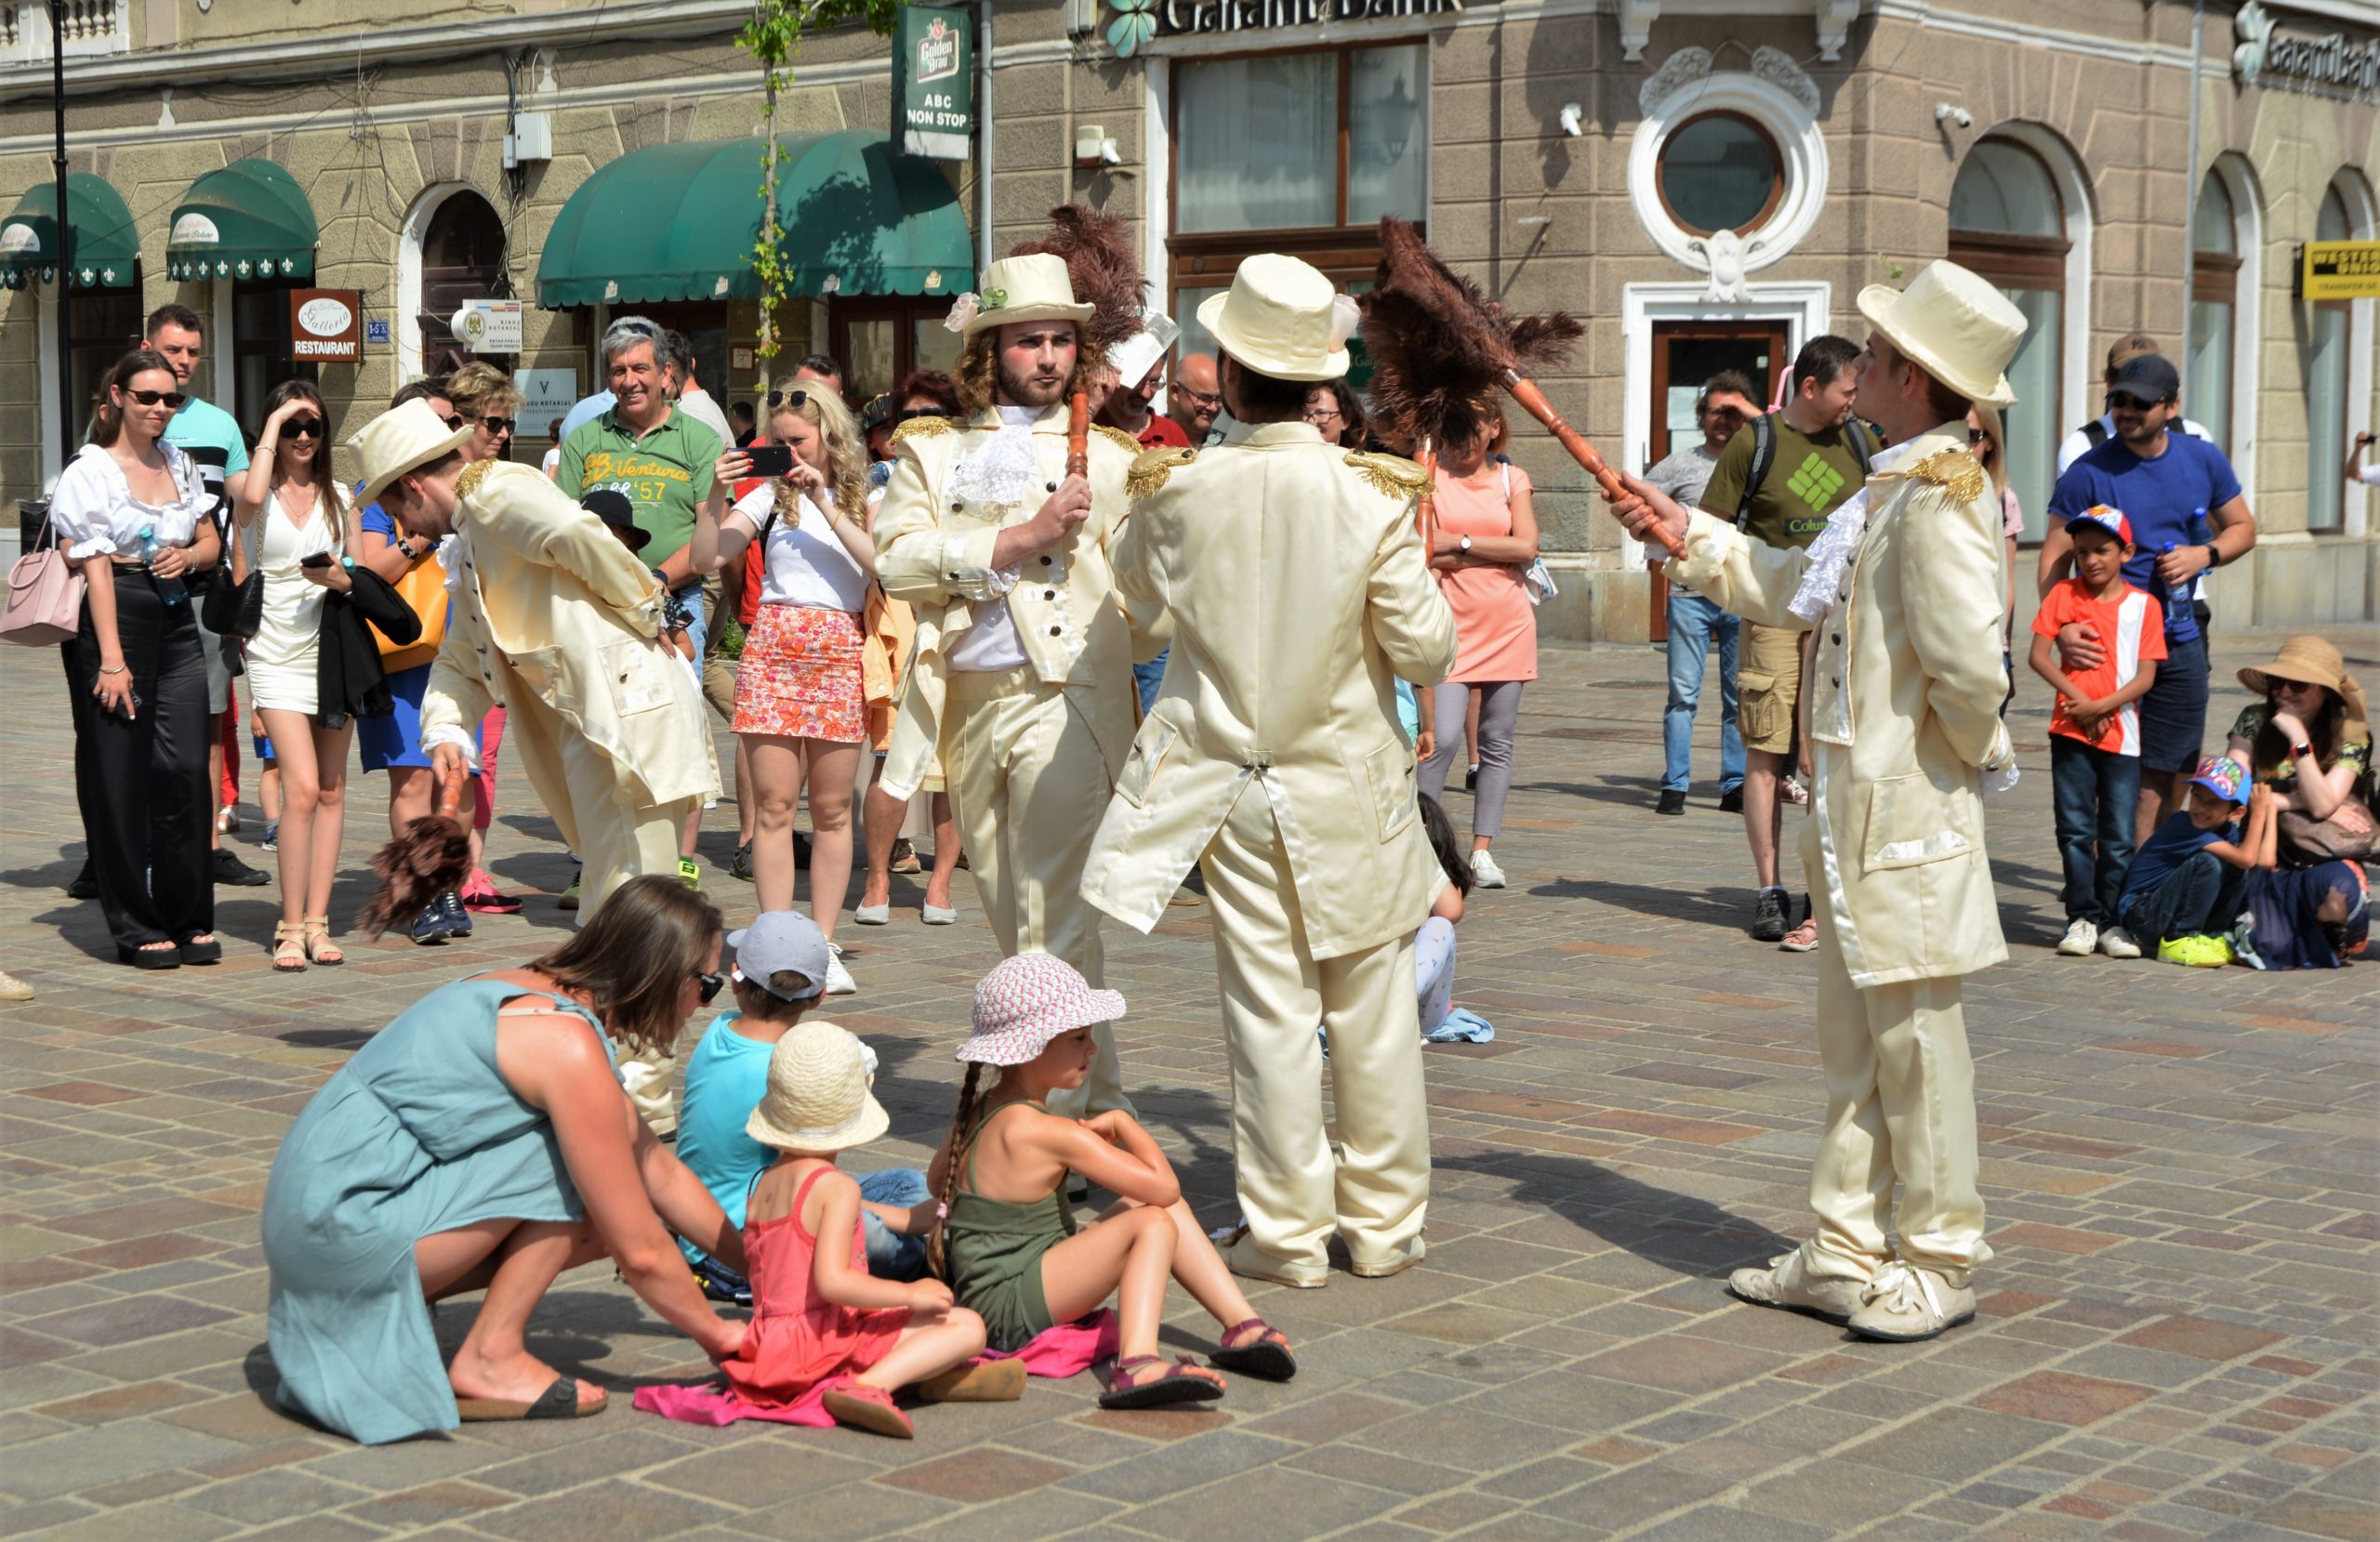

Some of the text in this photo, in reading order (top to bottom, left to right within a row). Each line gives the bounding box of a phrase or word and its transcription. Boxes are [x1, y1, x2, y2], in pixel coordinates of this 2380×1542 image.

[921, 40, 953, 60] Golden
[924, 94, 952, 109] ABC
[907, 109, 967, 127] NON STOP
[295, 340, 356, 355] RESTAURANT
[614, 457, 691, 482] Ventura
